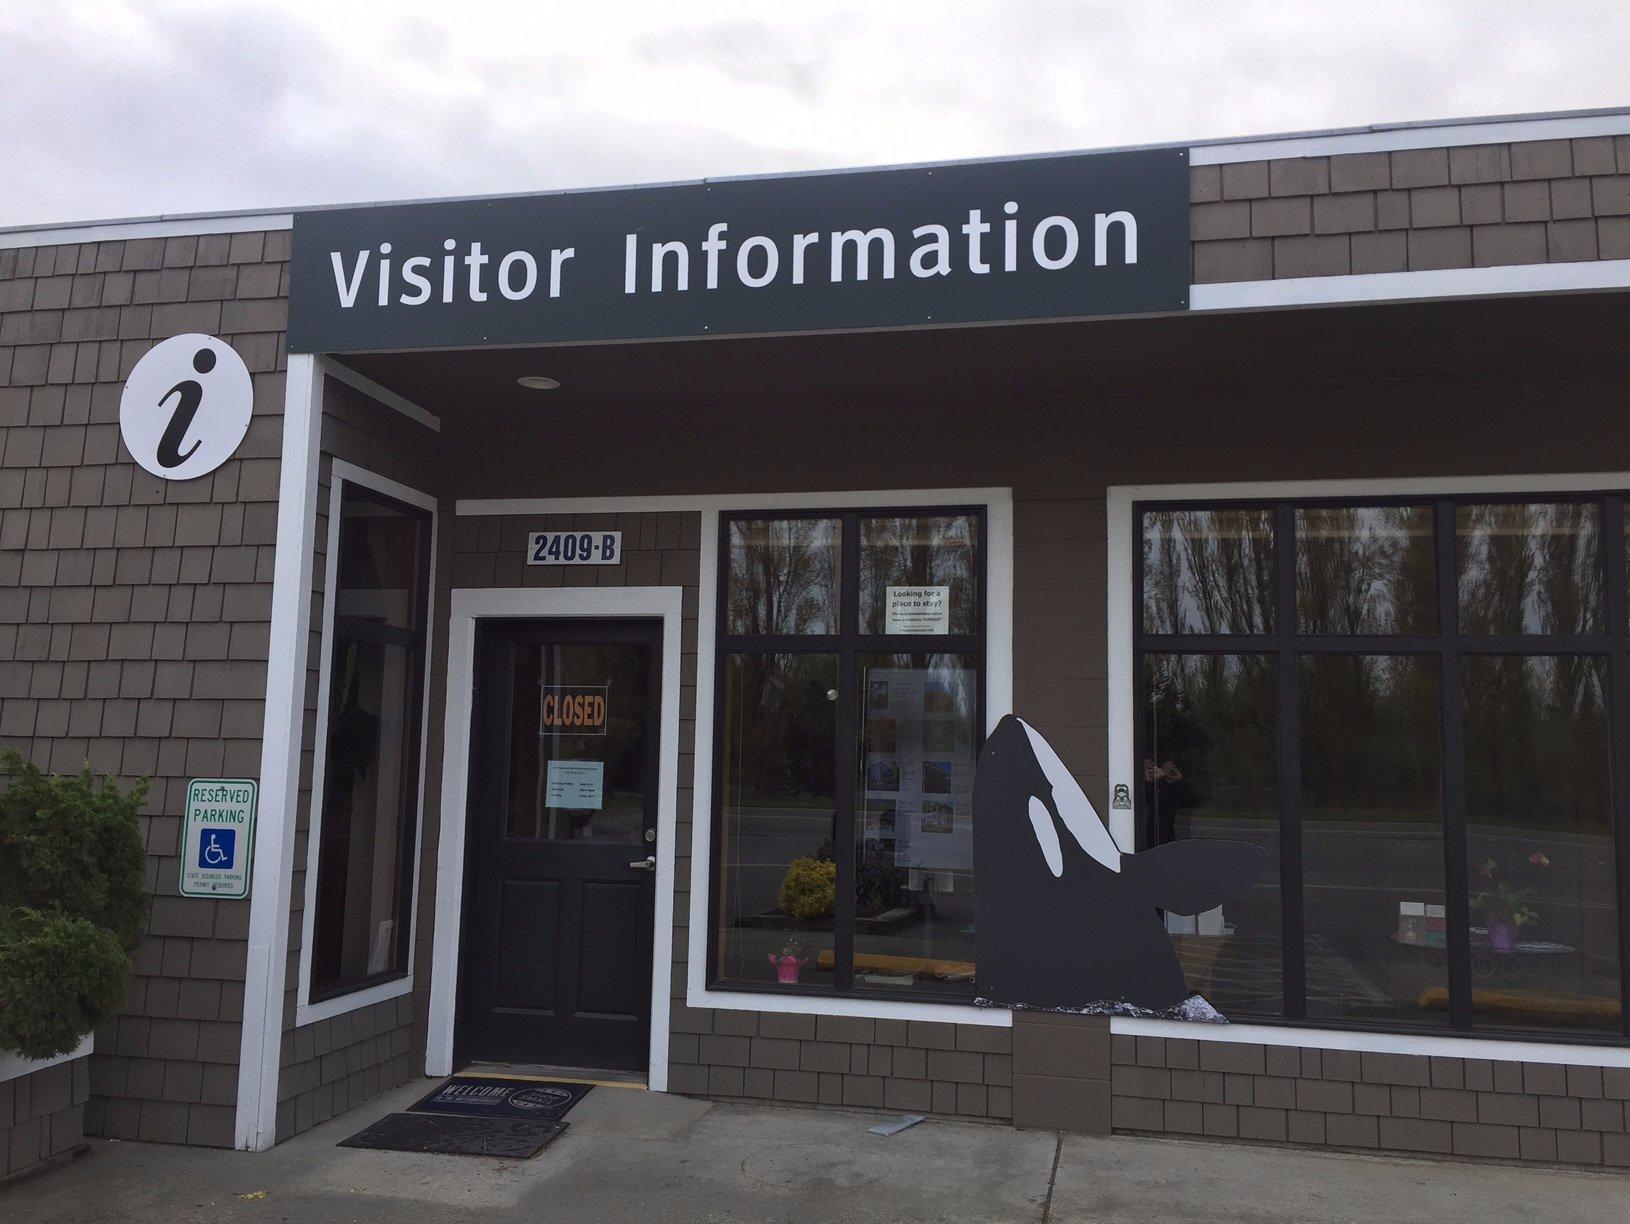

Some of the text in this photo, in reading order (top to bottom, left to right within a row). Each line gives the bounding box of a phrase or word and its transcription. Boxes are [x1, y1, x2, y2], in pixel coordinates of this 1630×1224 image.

[330, 201, 1138, 308] Visitor Information
[156, 347, 217, 469] i
[533, 534, 616, 561] 2409-B
[893, 590, 922, 598] Looking
[892, 600, 911, 608] place
[922, 600, 942, 608] stay?
[543, 694, 605, 726] CLOSED
[193, 788, 250, 804] RESERVED
[193, 808, 245, 823] PARKING
[442, 1085, 515, 1097] WELCOME
